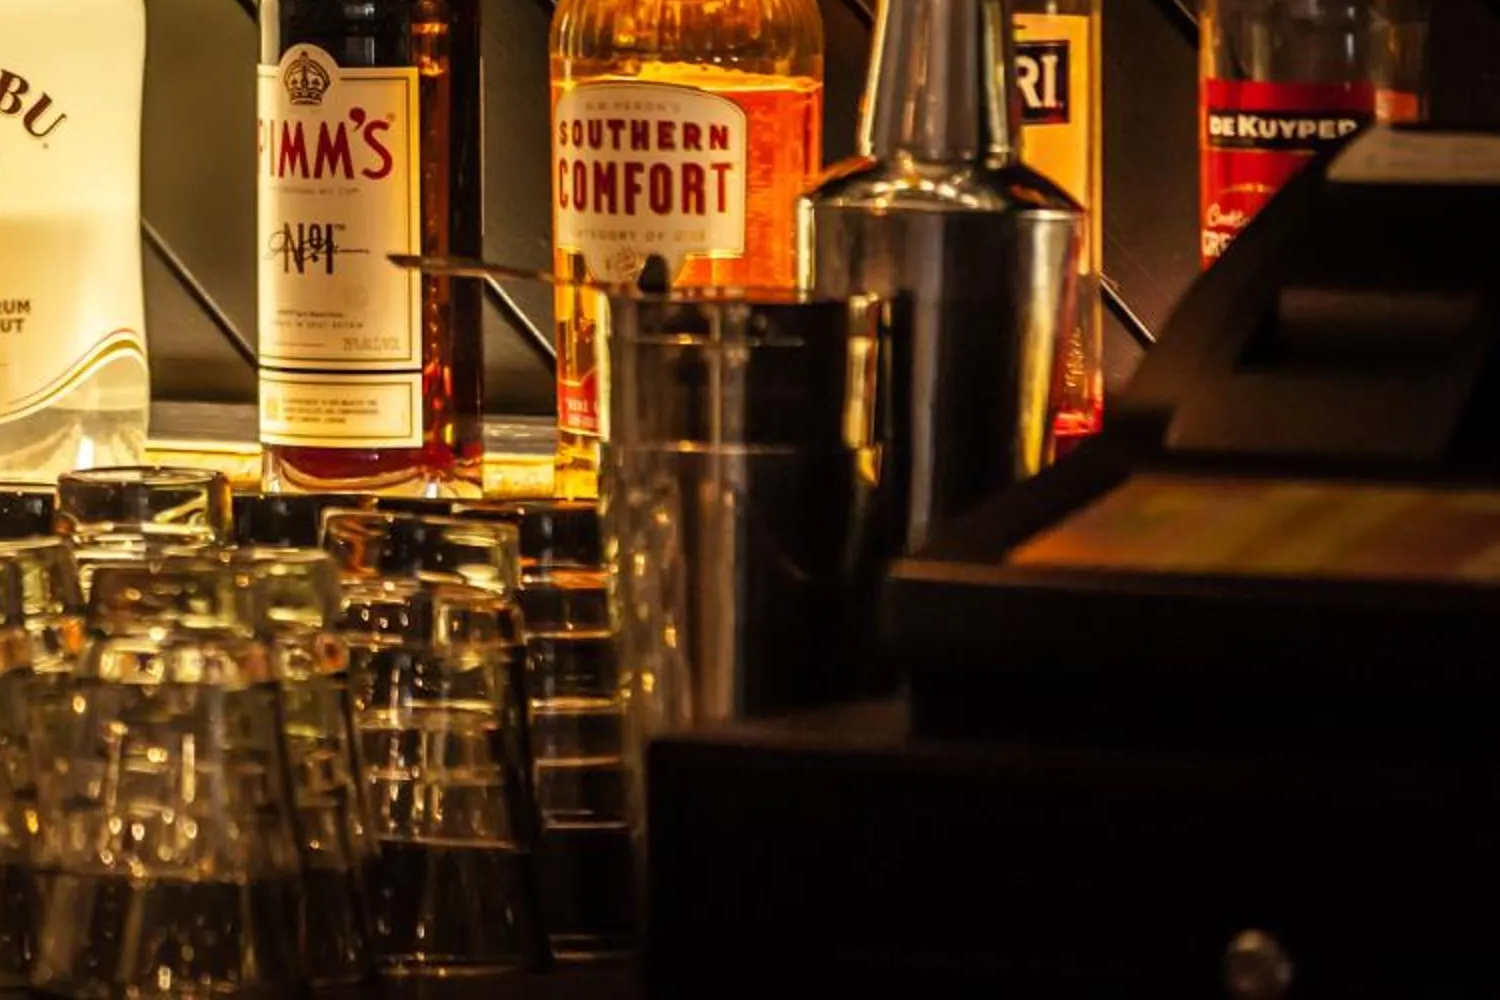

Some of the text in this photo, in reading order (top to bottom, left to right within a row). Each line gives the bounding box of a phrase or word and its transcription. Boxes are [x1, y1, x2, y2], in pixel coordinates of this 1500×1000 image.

[259, 107, 393, 180] IMM'S
[560, 119, 730, 151] SOUTHERN
[558, 157, 732, 216] COMFORT
